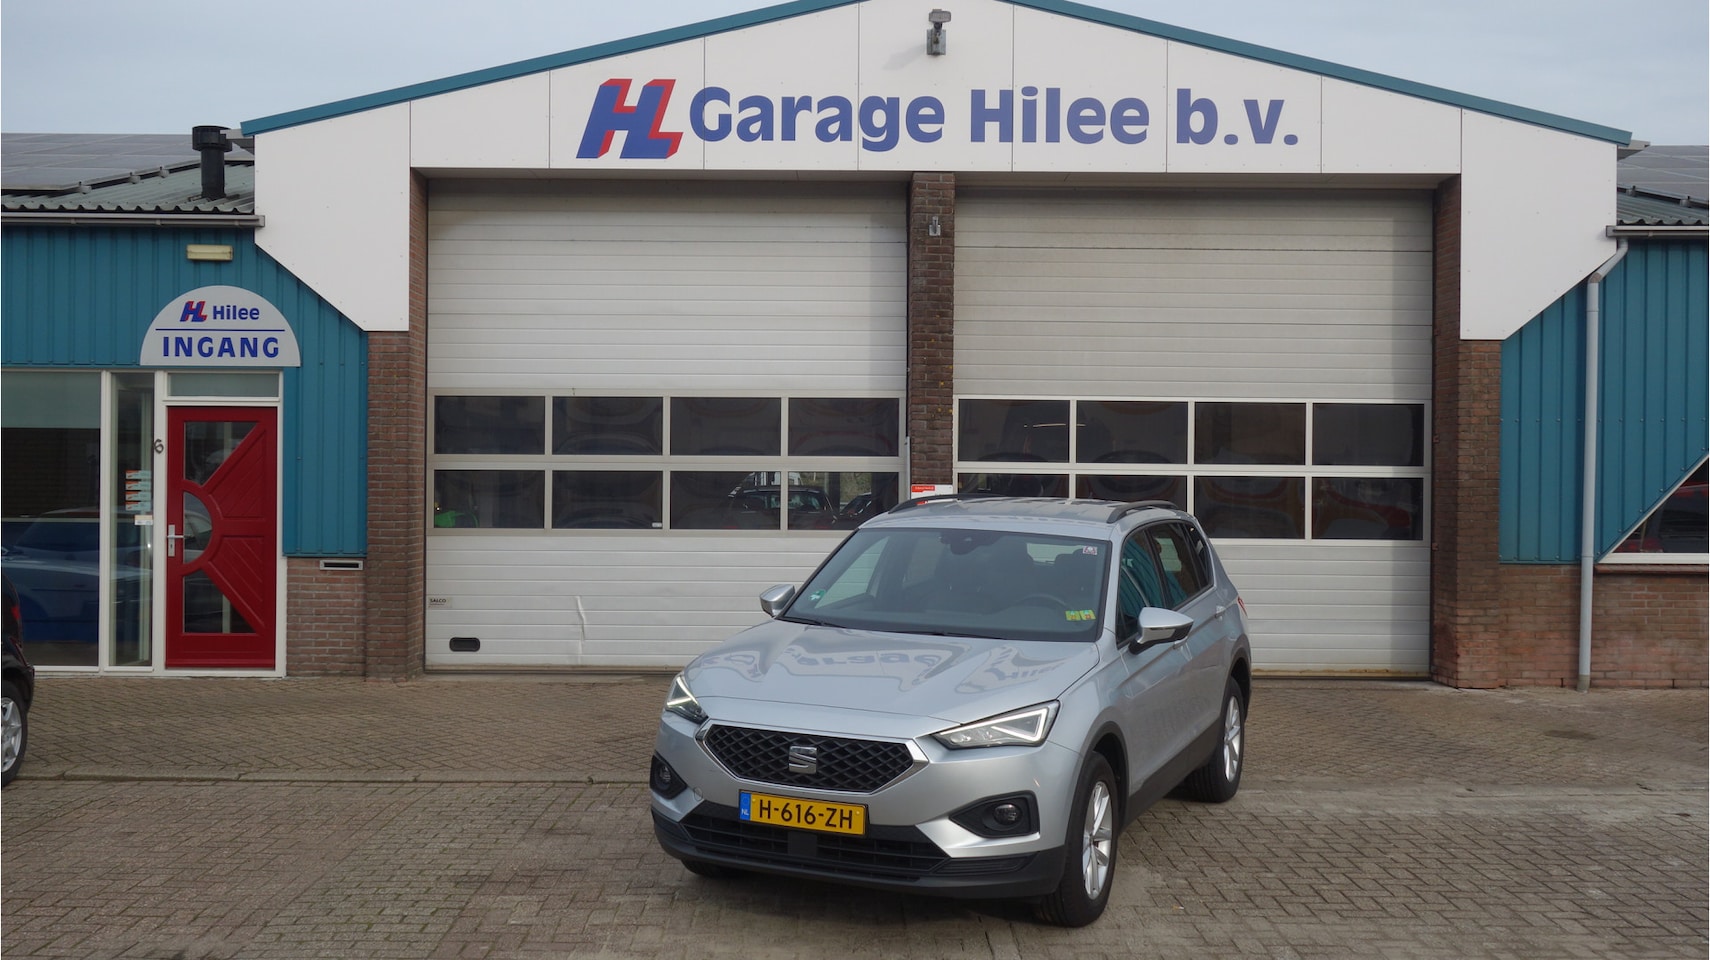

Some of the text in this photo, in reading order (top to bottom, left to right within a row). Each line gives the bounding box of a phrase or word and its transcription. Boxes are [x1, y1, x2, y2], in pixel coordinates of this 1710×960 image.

[689, 86, 945, 153] Garage
[970, 86, 1150, 145] Hilee
[1176, 88, 1299, 145] b.v.
[212, 305, 260, 320] Hilee
[163, 336, 279, 358] INGANG
[154, 439, 164, 454] 6
[741, 808, 750, 816] NL
[759, 799, 853, 829] H-616-ZH
